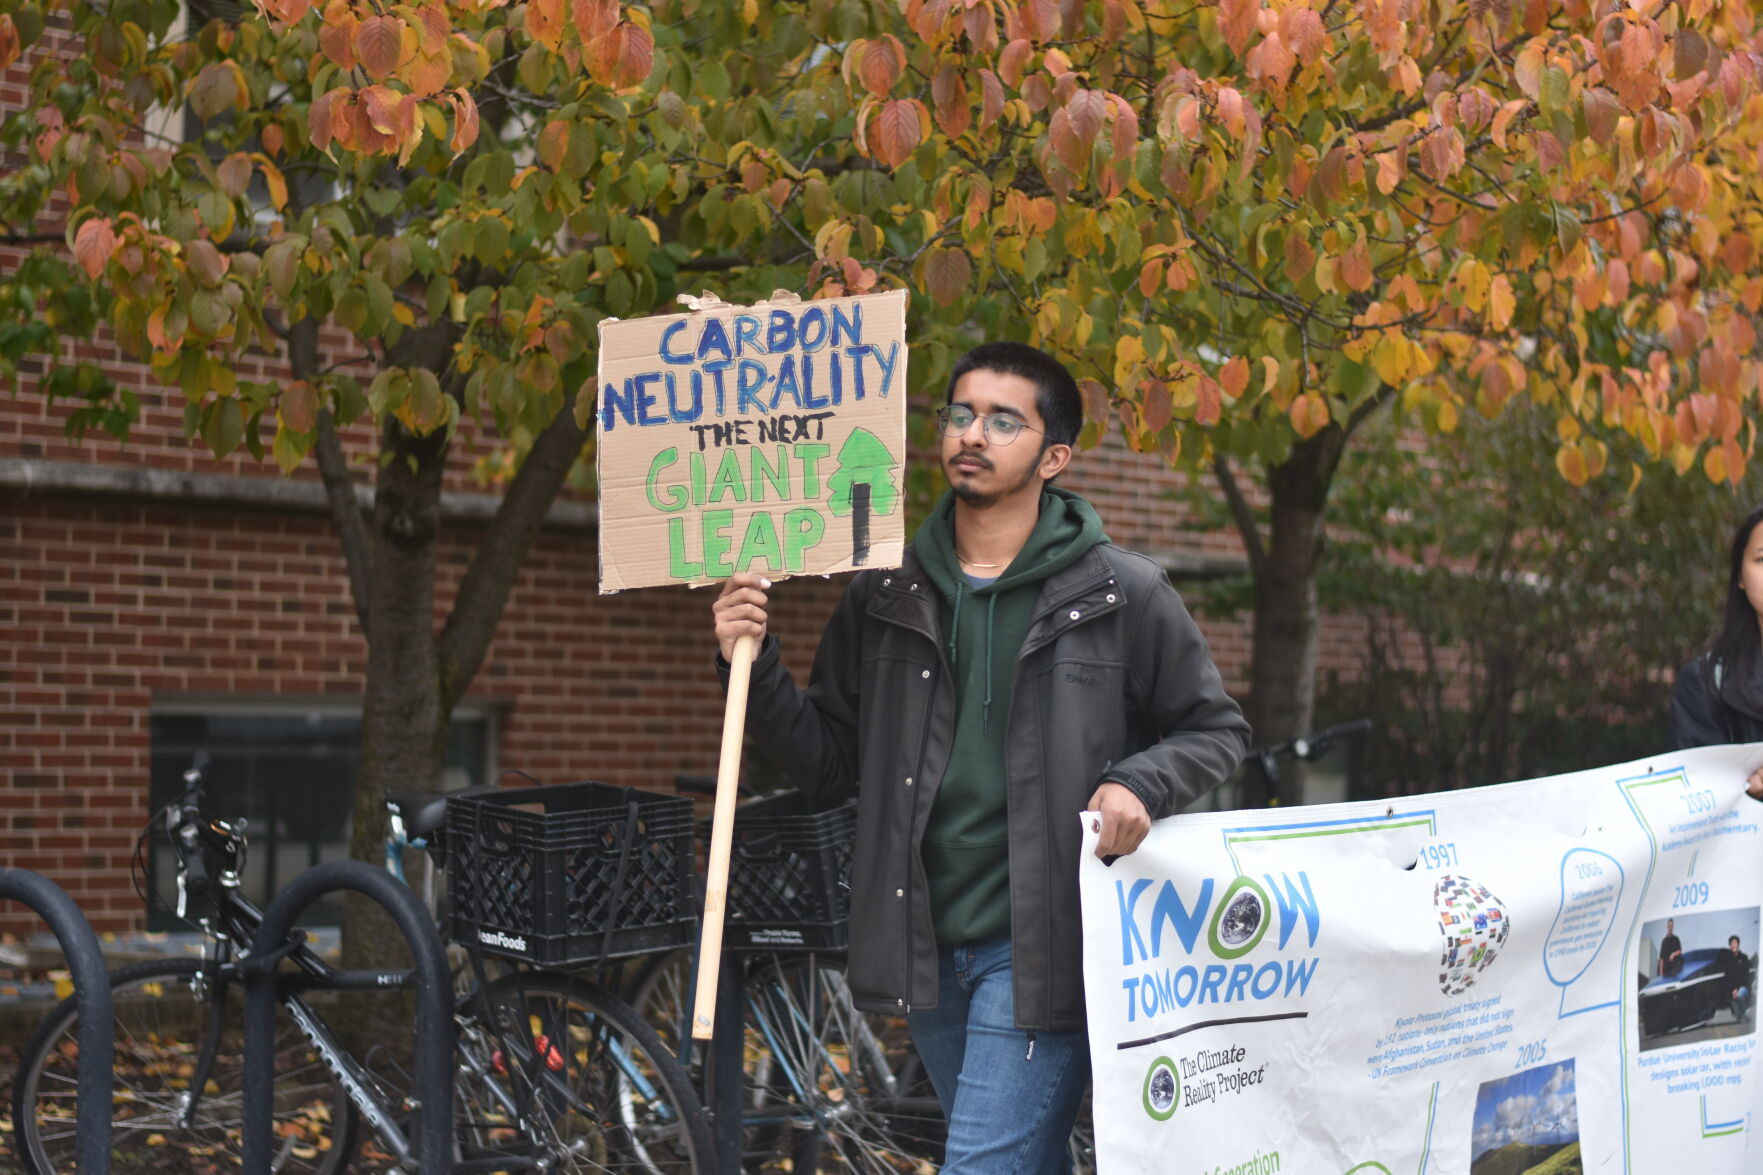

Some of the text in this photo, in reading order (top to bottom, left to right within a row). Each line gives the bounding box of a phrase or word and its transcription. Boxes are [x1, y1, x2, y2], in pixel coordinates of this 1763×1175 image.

[659, 302, 863, 365] CARBON
[602, 340, 900, 432] NEUTRALITY
[689, 411, 836, 451] THE NEXT
[646, 443, 830, 512] GIANT
[668, 508, 825, 579] LEAP
[1680, 789, 1716, 814] 2007
[1420, 843, 1459, 870] 1997
[1672, 881, 1709, 908] 2009
[1115, 870, 1321, 966] KNOW
[1122, 957, 1320, 1022] TOMORROW
[1180, 1043, 1246, 1080] The Climate
[1514, 1038, 1547, 1068] 2005
[1183, 1065, 1265, 1108] Reality Project
